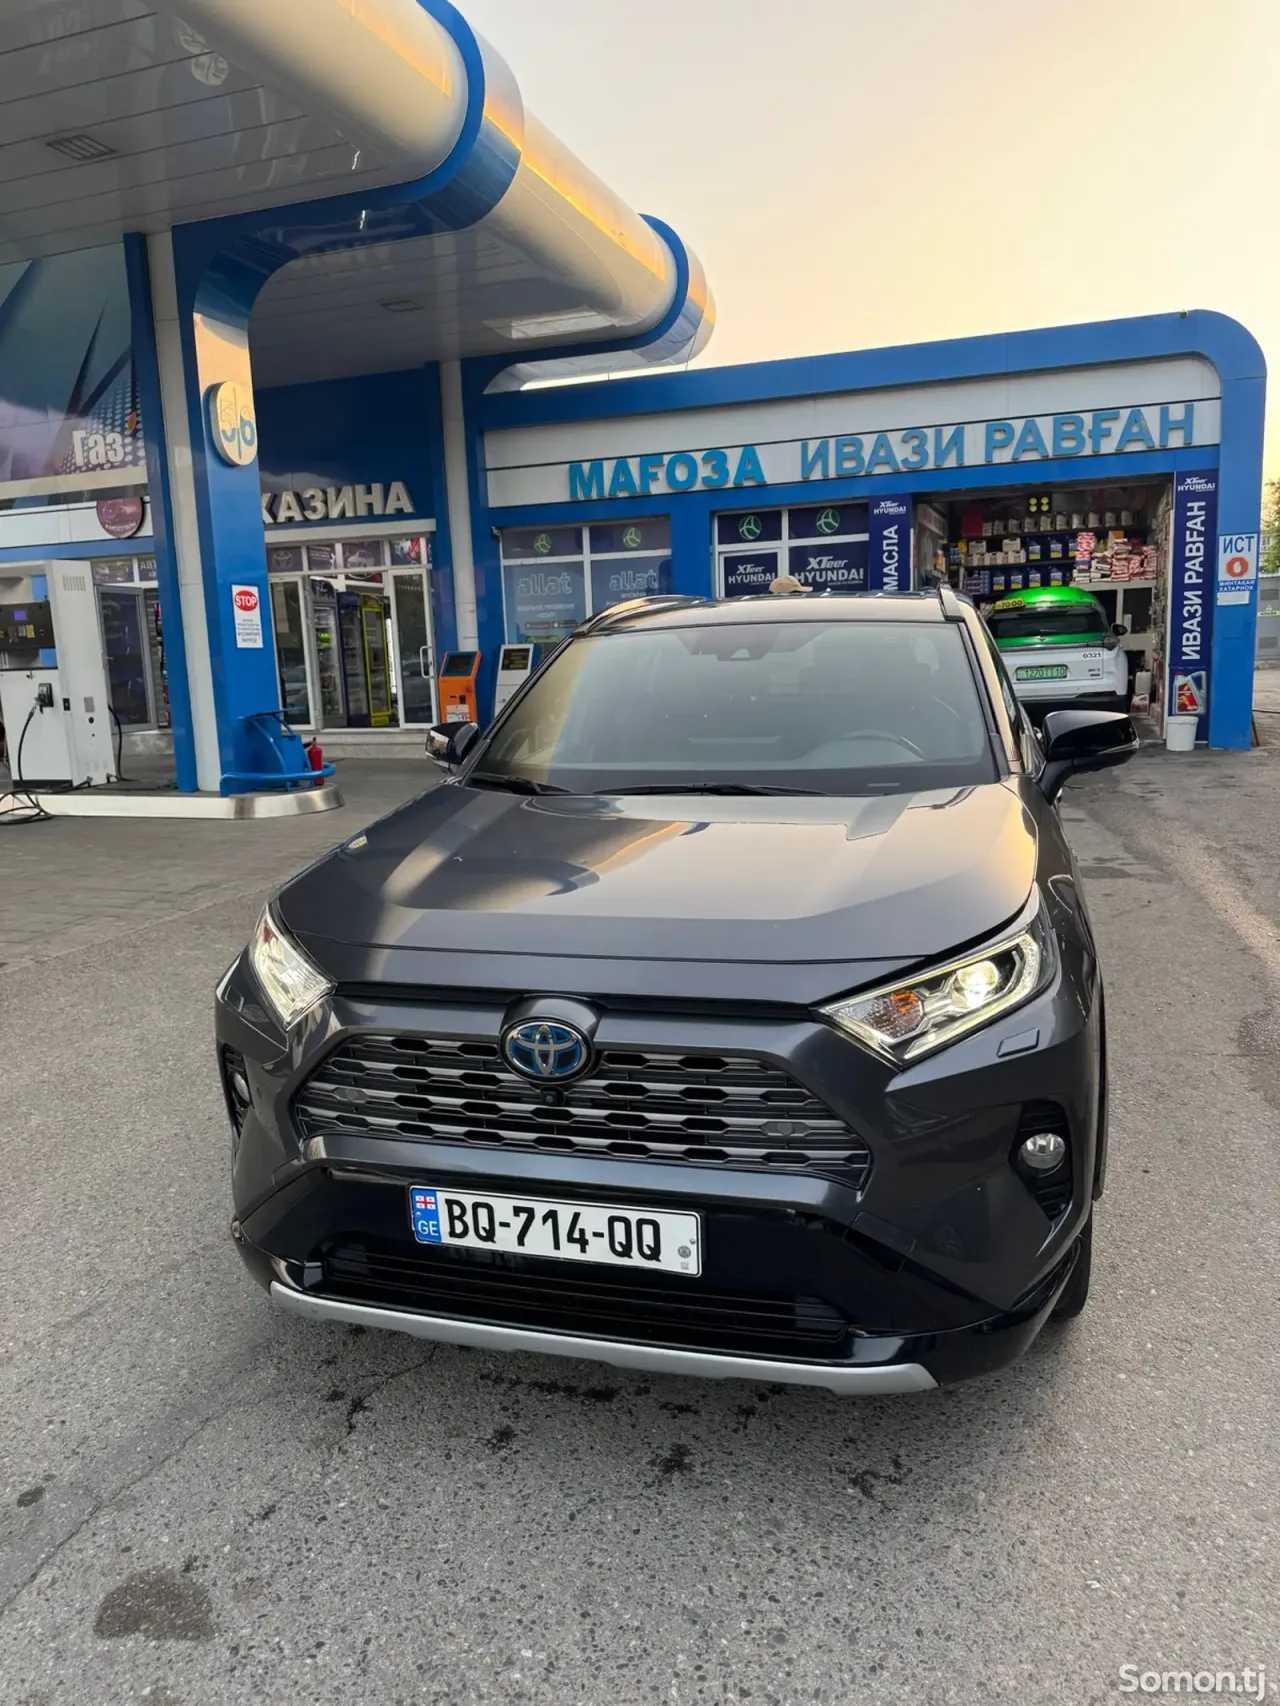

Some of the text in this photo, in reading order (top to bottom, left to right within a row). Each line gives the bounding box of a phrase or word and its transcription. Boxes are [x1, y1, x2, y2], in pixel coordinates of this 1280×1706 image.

[71, 430, 125, 467] Газ
[801, 425, 965, 480] ИВАЗИ
[1178, 483, 1216, 492] HYUNDAI
[874, 506, 906, 515] HYUNDAI
[1223, 535, 1255, 553] ИСТ
[806, 556, 848, 570] XTeer
[882, 524, 899, 590] МАСЛА
[736, 564, 765, 574] XTeer
[795, 568, 864, 584] HYUNDAI
[518, 572, 572, 596] allat
[609, 569, 658, 592] allat
[728, 572, 775, 584] HYUNDAI
[235, 595, 257, 607] STOP
[1181, 590, 1203, 660] ИВАЗИ
[417, 1220, 439, 1236] GE
[445, 1198, 662, 1263] BQ-714-QQ
